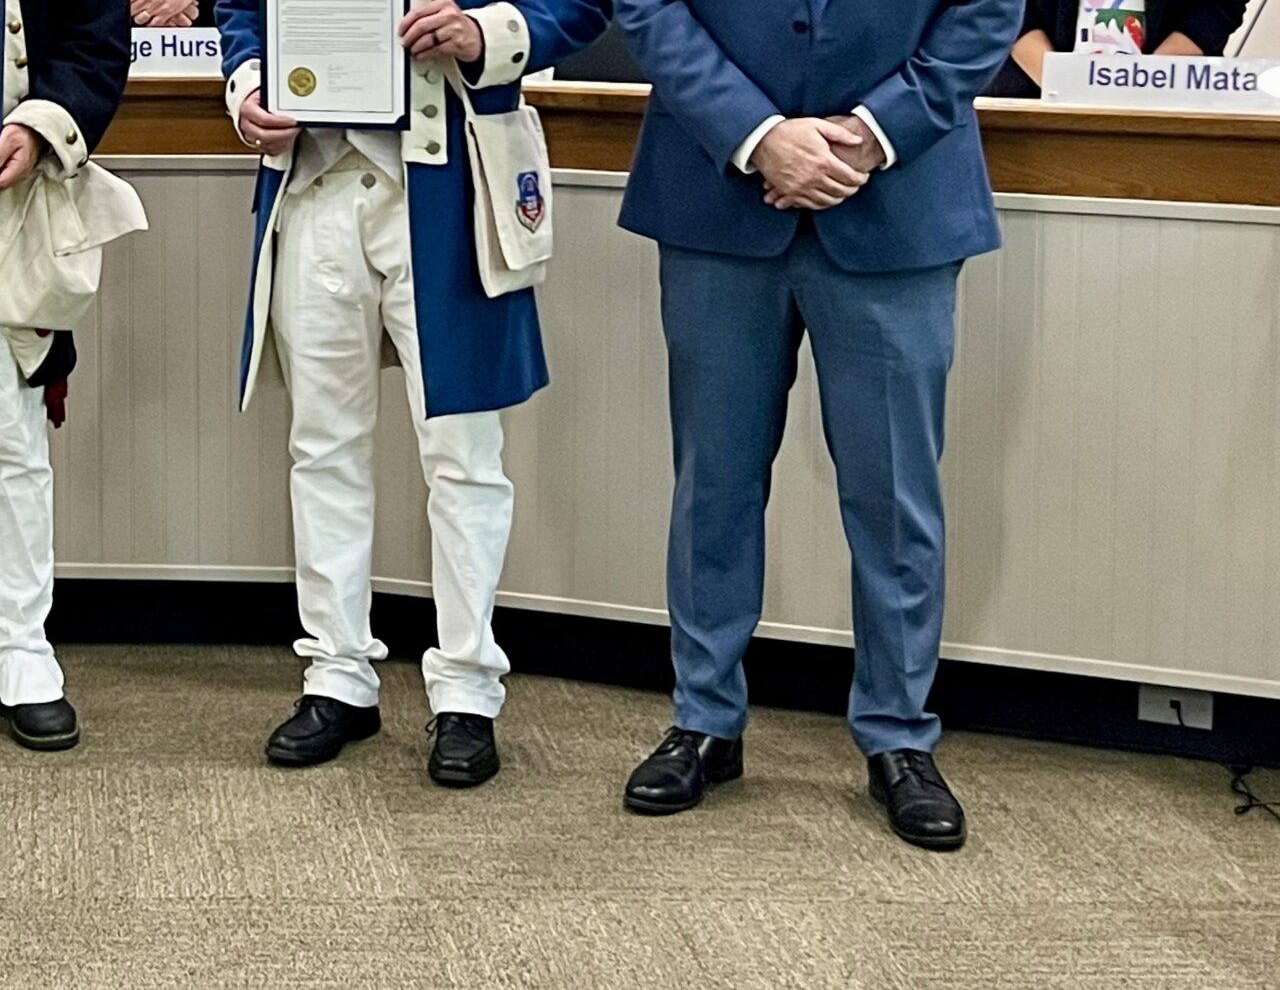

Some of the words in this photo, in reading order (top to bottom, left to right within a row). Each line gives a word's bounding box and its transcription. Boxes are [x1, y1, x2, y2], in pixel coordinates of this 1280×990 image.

[161, 35, 221, 58] Hurs
[1088, 61, 1175, 89] Isabel
[1186, 64, 1259, 91] Mata
